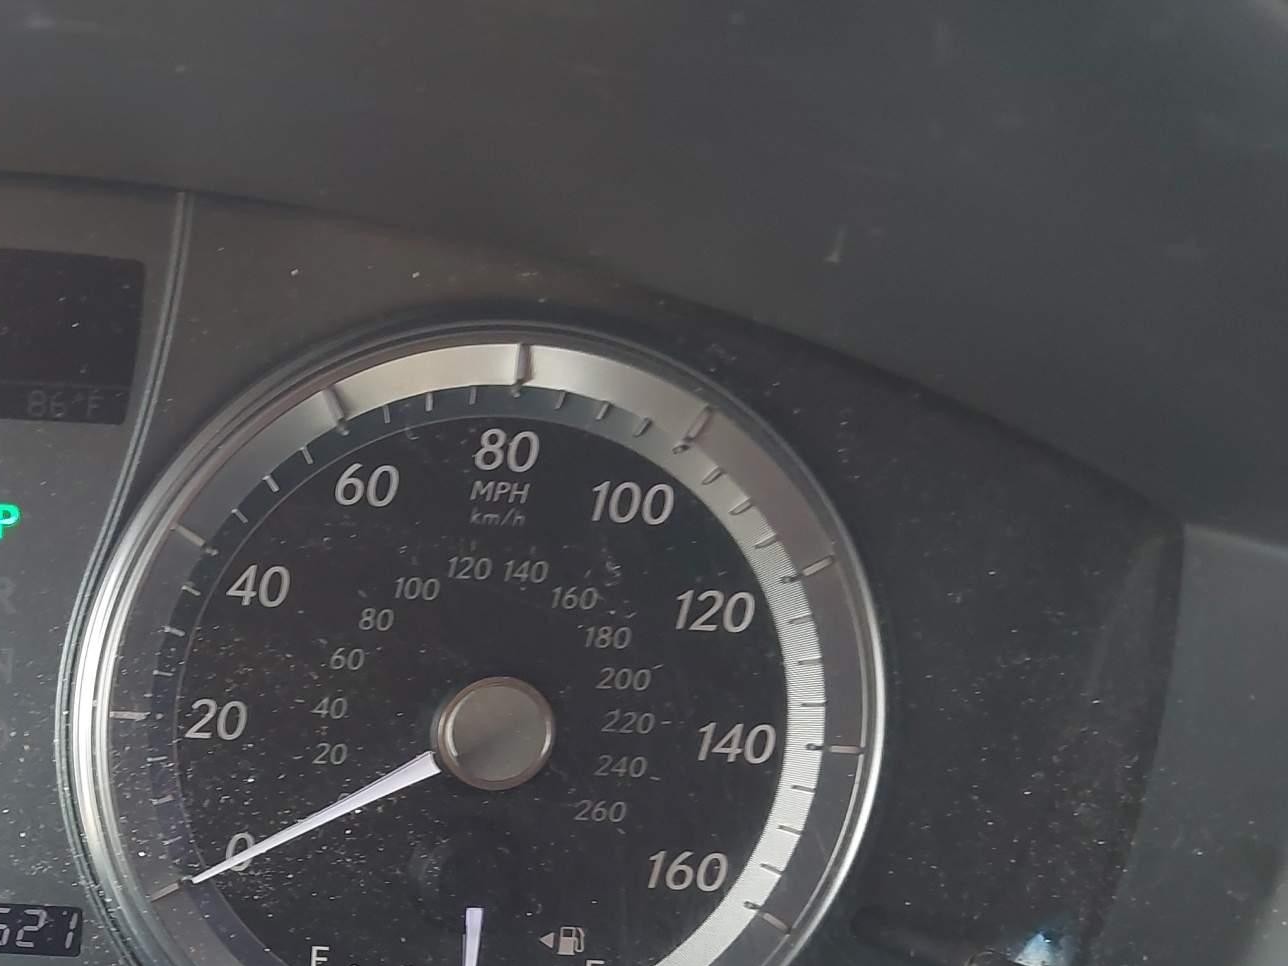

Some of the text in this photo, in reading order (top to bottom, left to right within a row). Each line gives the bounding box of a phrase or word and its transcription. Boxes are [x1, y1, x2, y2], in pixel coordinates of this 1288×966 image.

[473, 428, 540, 473] 80
[334, 463, 400, 507] 60
[470, 480, 531, 504] MPH
[591, 481, 676, 525] 100
[468, 506, 527, 528] km/h
[447, 556, 493, 580] 120
[503, 559, 550, 583] 140
[226, 564, 292, 607] 40
[393, 577, 441, 601] 100
[550, 586, 600, 610] 160
[359, 607, 394, 631] 80
[674, 589, 756, 633] 120
[583, 625, 633, 649] 180
[329, 647, 365, 671] 60
[595, 666, 652, 691] 200
[184, 698, 248, 741] 20
[311, 697, 348, 719] 40
[600, 709, 655, 734] 220
[312, 742, 348, 765] 20
[696, 721, 776, 764] 140
[593, 754, 648, 778] 240
[573, 799, 627, 823] 260
[225, 832, 256, 872] 0
[647, 850, 729, 892] 160
